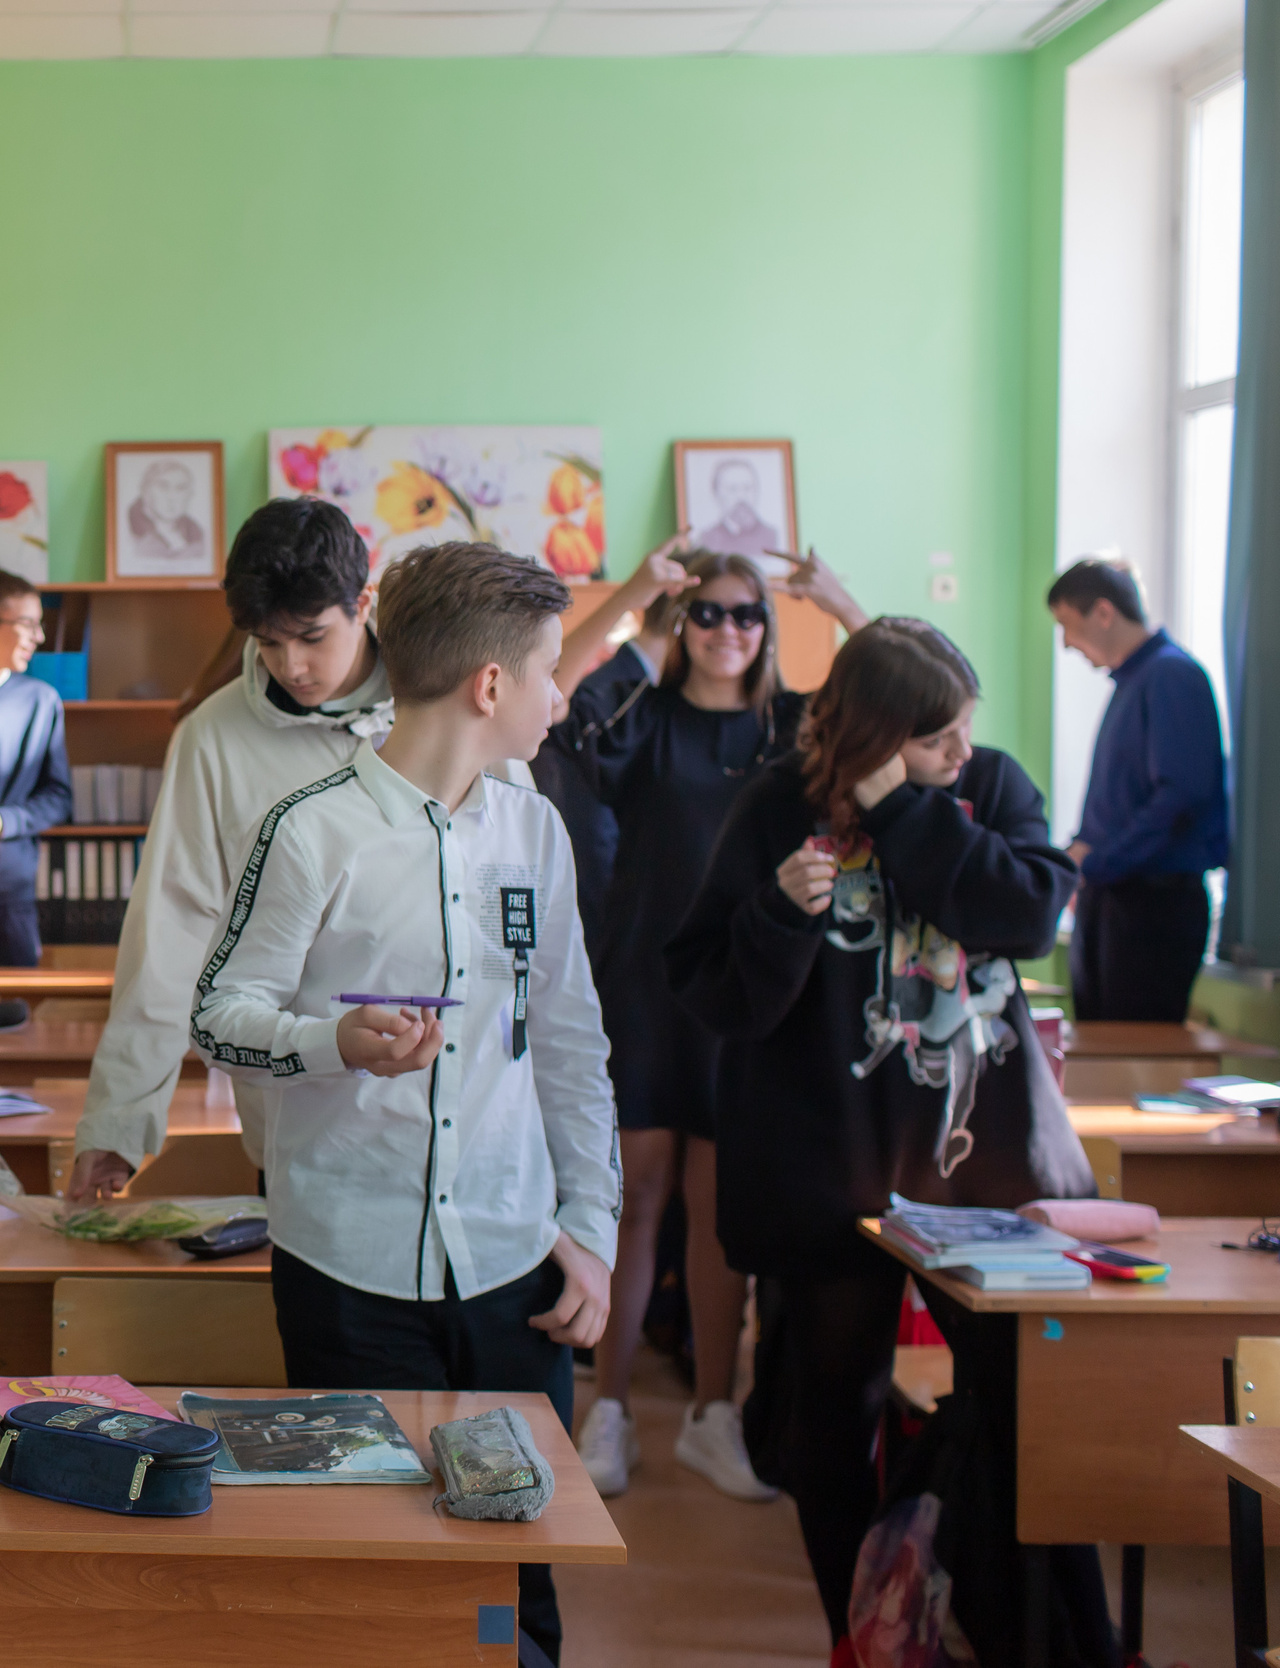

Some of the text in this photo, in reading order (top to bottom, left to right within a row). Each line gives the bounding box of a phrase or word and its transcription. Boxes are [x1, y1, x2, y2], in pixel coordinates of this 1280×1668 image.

[199, 955, 224, 988] STYLE
[217, 931, 238, 958] FREE
[238, 869, 258, 904] STYLE
[248, 841, 266, 871] FREE
[276, 791, 306, 814] STYLE
[507, 893, 528, 909] FREE
[507, 910, 528, 925] HIGH
[506, 926, 532, 942] STYLE
